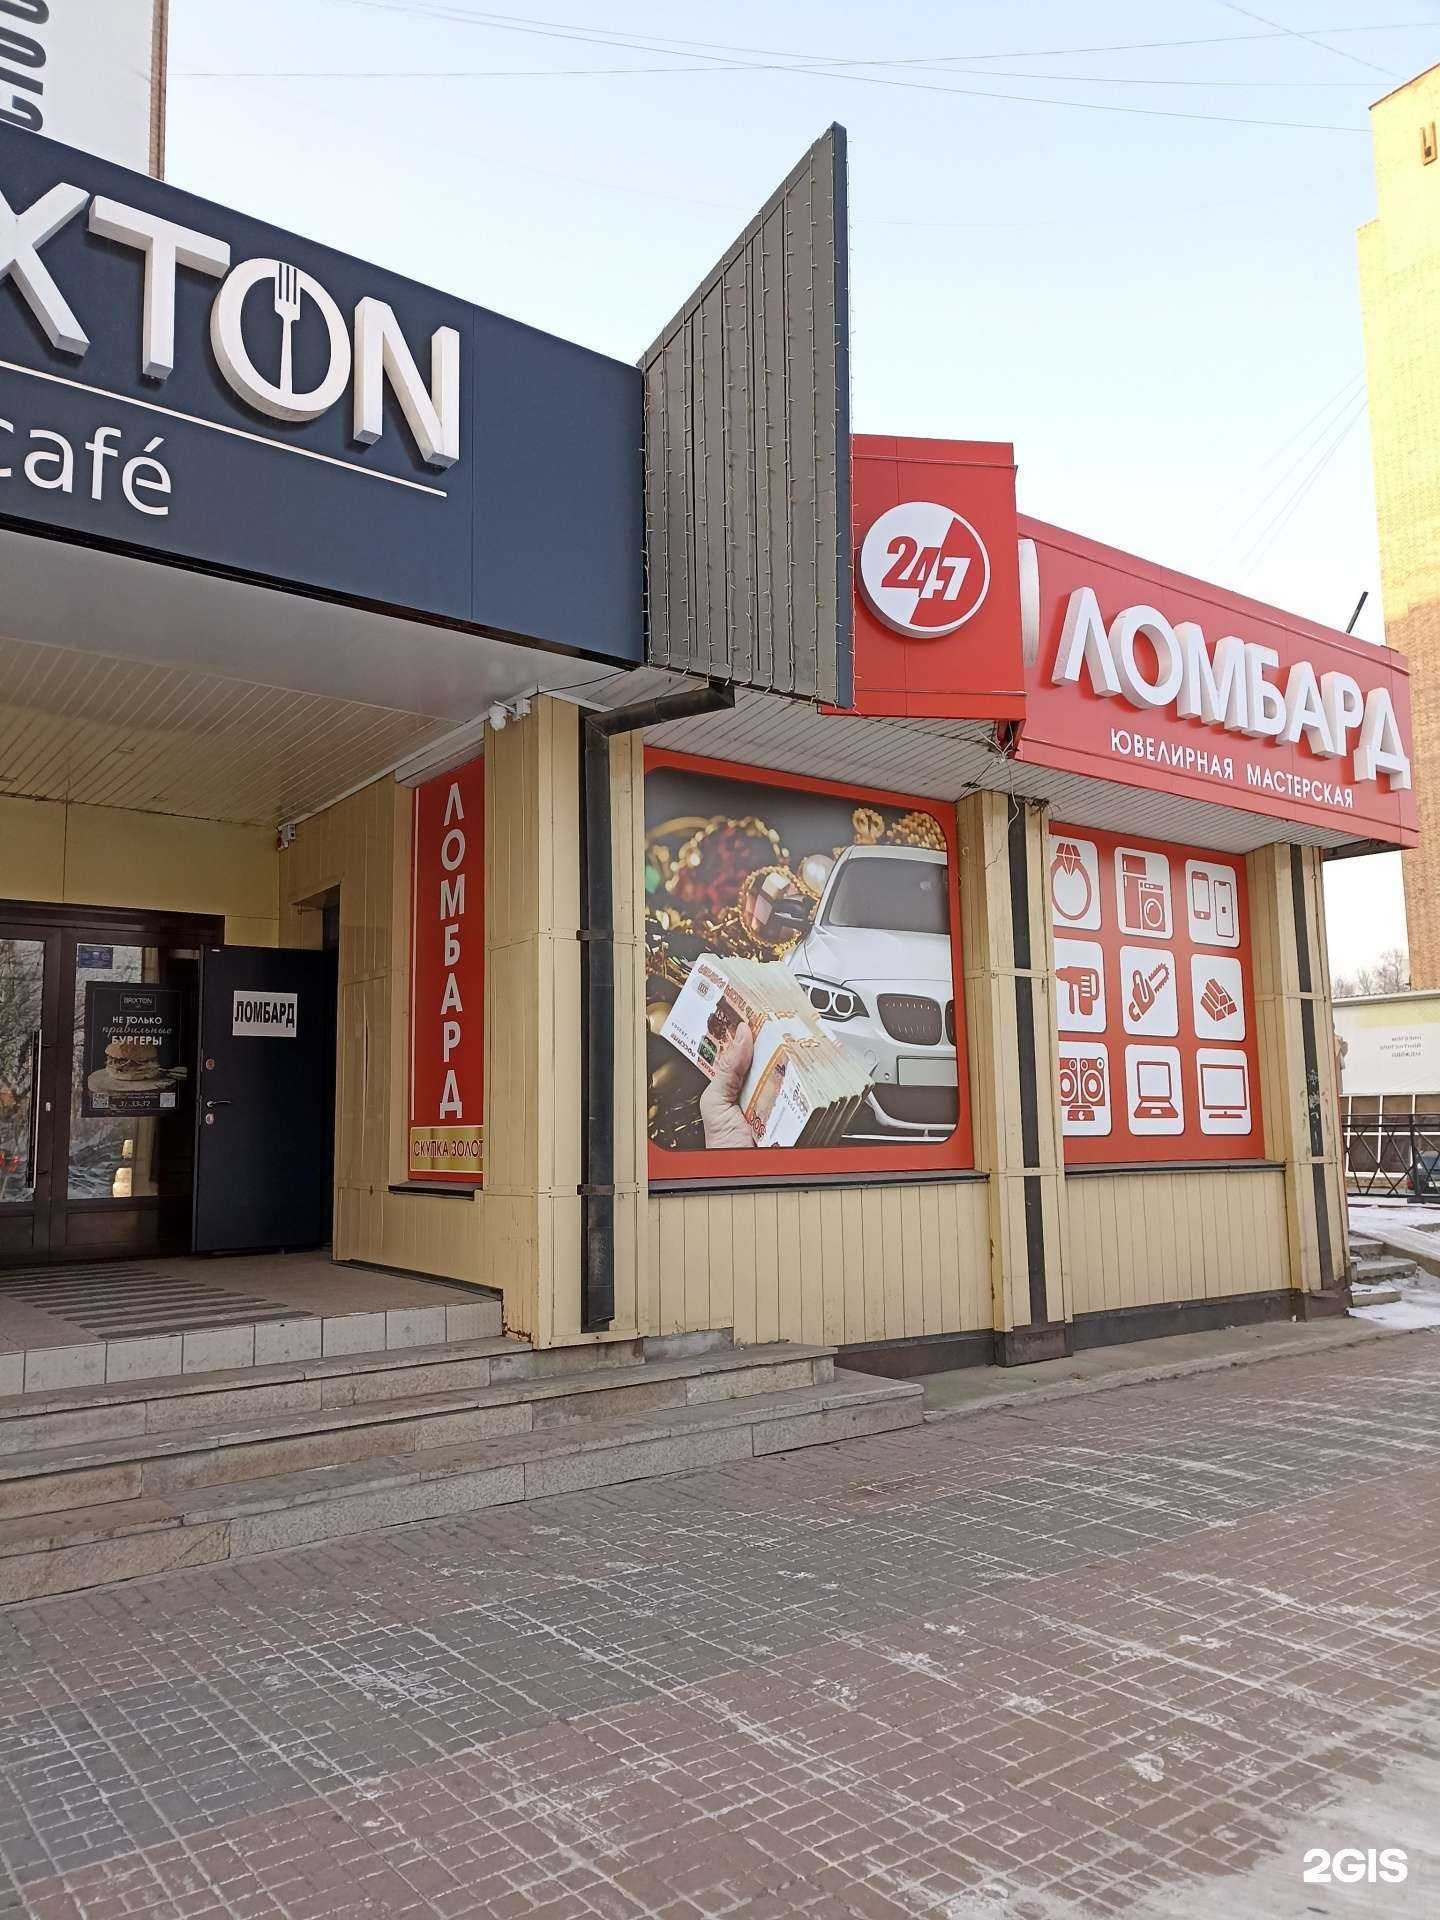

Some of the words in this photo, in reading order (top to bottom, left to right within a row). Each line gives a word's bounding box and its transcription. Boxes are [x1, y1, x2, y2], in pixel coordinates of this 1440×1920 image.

[0, 415, 172, 516] afé
[1051, 586, 1412, 791] ЛОМБАРД
[1110, 727, 1234, 780] ЮВЕЛИРНАЯ
[1246, 762, 1354, 808] МАСТЕРСКАЯ
[439, 782, 466, 1119] ЛОМБАРД
[111, 1035, 162, 1046] БУРГЕРЫ
[112, 1016, 123, 1024] НЕ
[126, 1016, 162, 1025] ТОЛЬКО
[234, 1000, 295, 1028] ЛОМБАРД
[413, 1140, 449, 1158] СКУПКА
